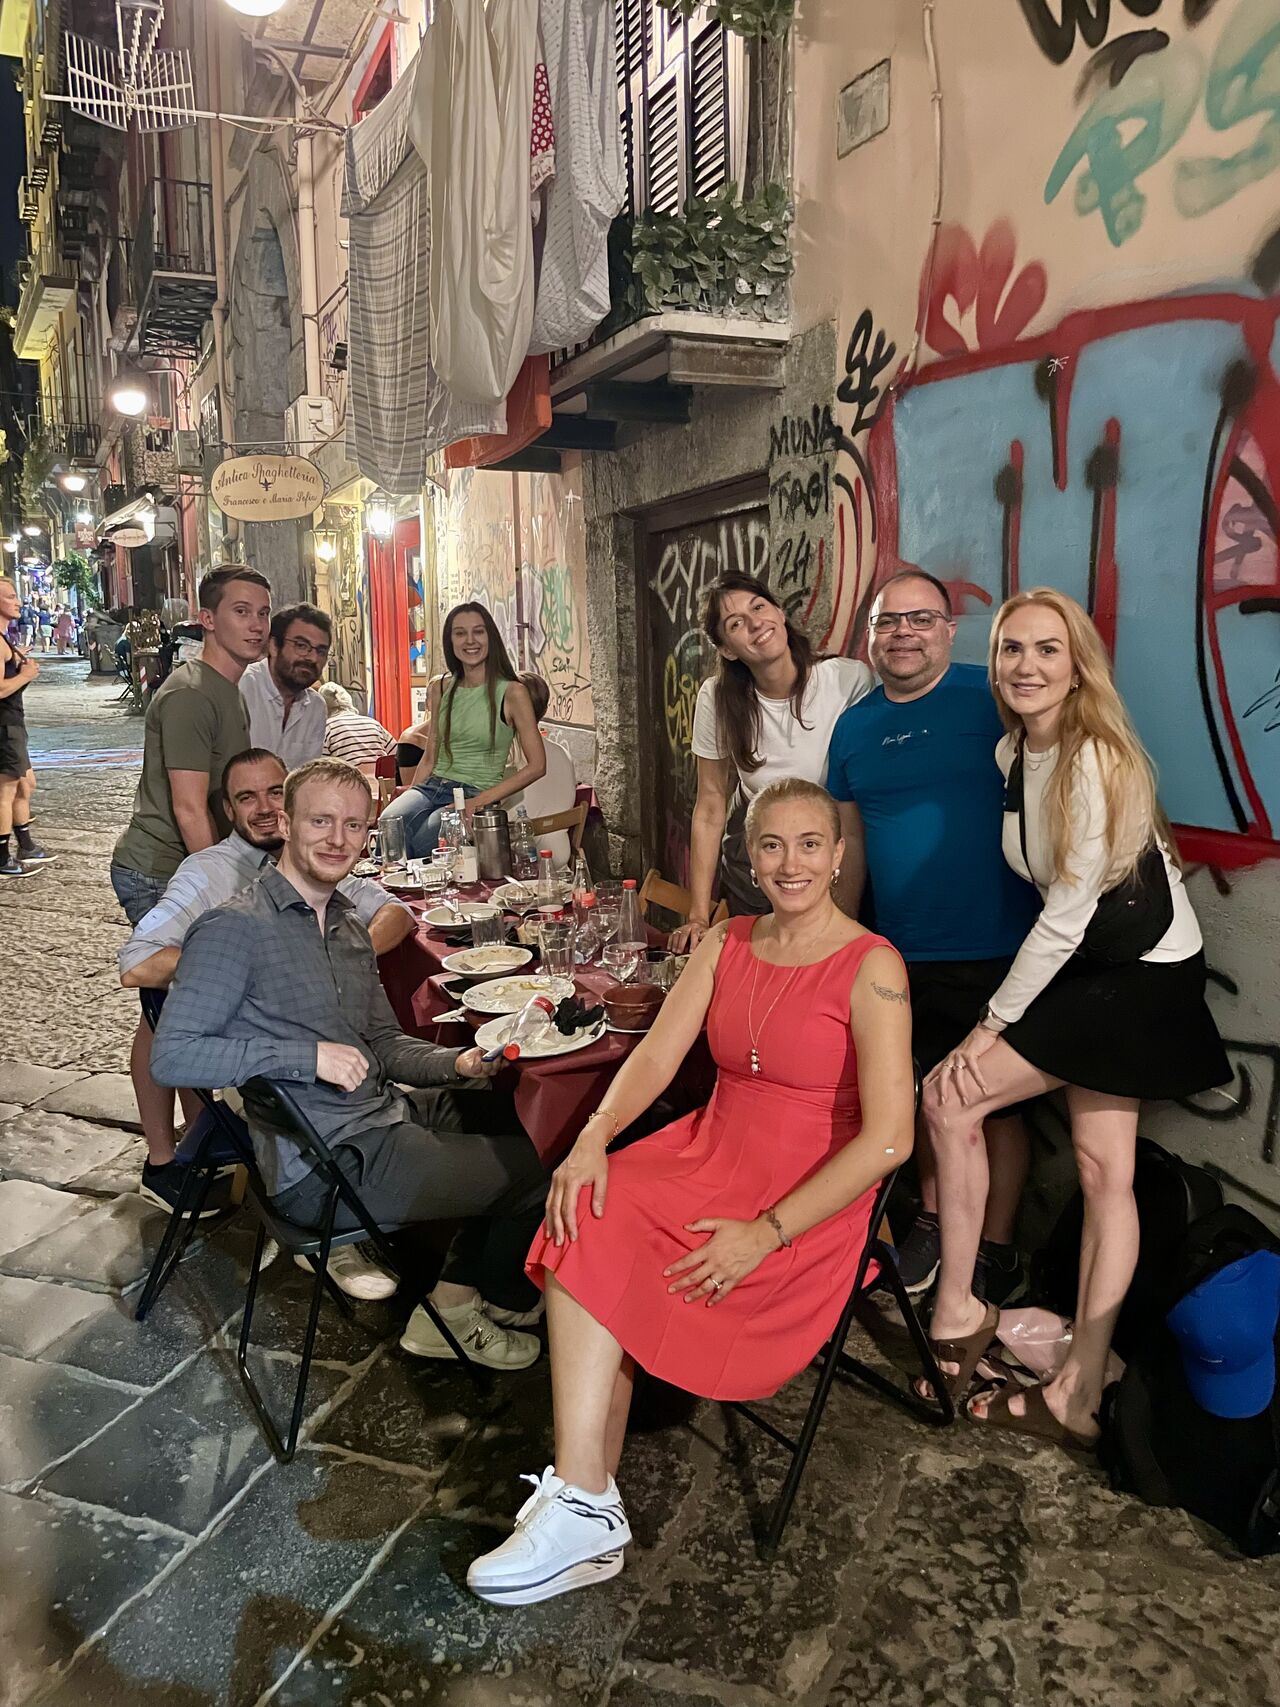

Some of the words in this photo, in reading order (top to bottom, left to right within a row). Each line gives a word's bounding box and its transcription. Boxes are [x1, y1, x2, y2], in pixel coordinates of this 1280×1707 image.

[215, 469, 249, 491] Antica
[252, 462, 316, 485] Spaghetteria
[223, 495, 260, 506] Francesco
[269, 493, 293, 503] Maria
[462, 1324, 495, 1351] N
